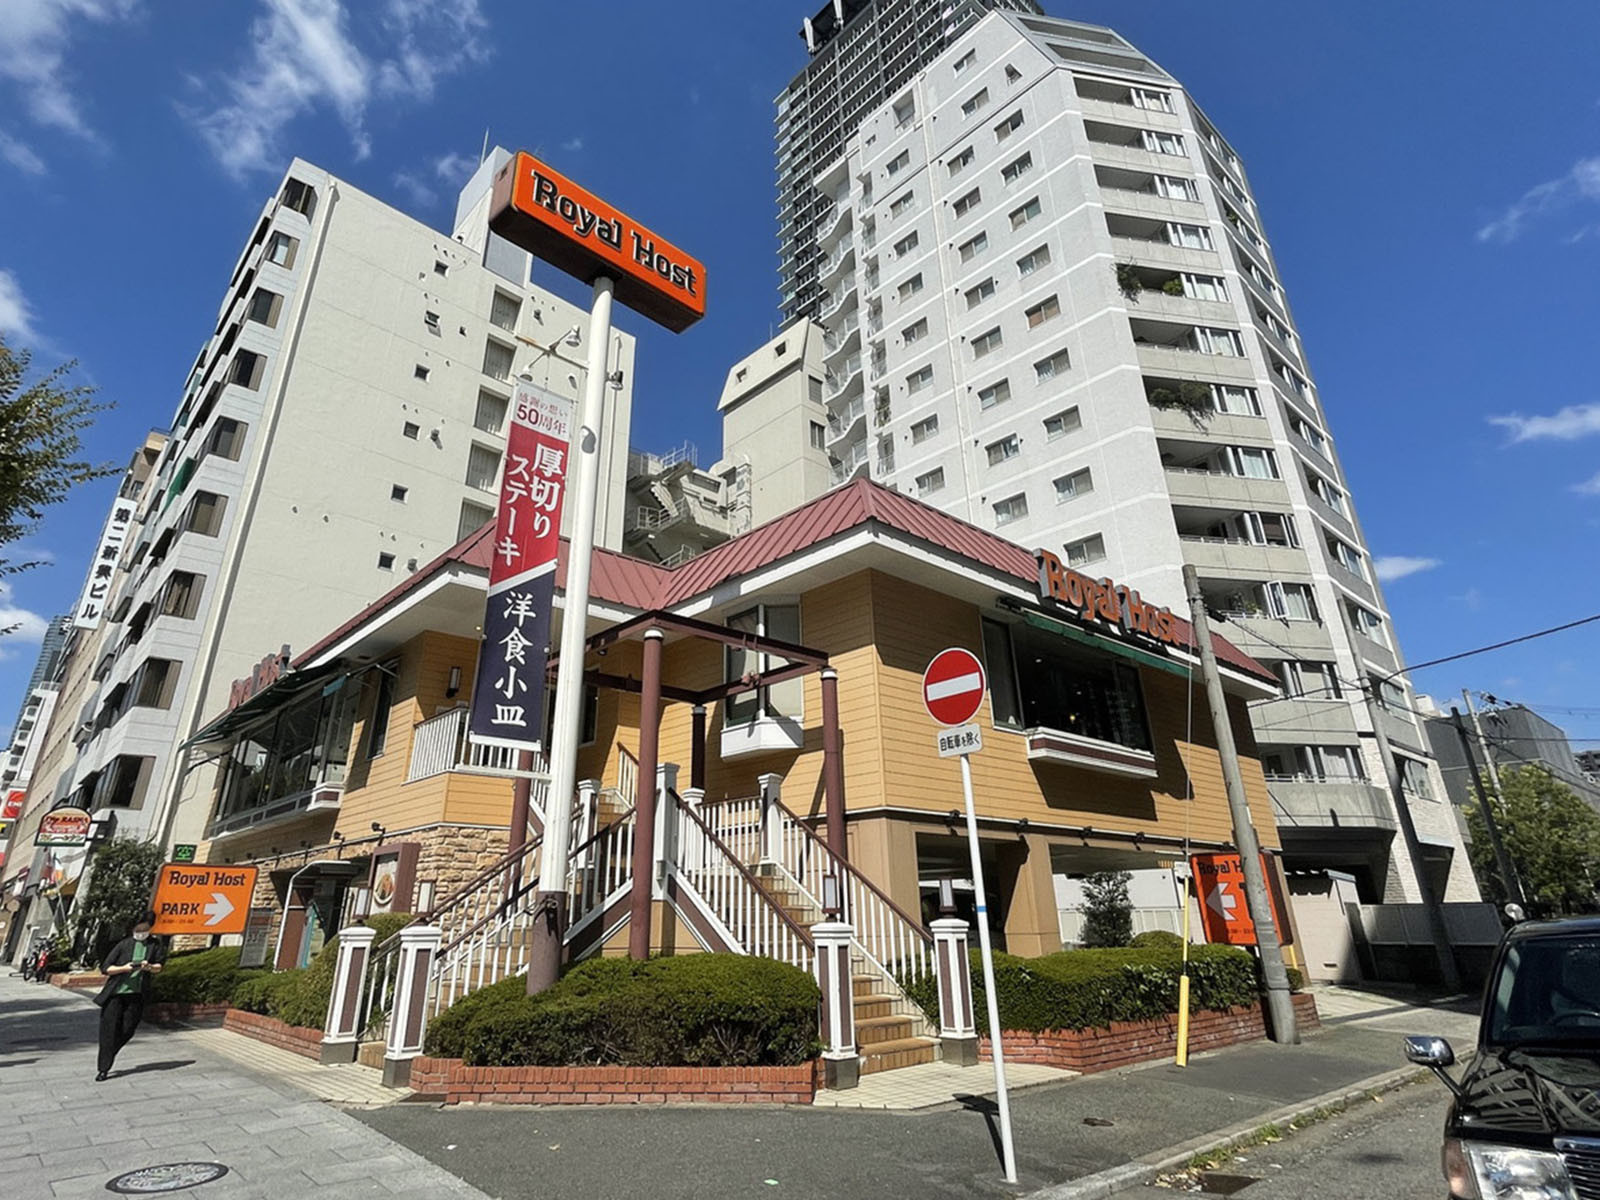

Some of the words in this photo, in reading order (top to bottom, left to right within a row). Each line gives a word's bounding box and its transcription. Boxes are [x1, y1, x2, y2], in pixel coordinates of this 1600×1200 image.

[531, 168, 624, 253] Royal
[630, 228, 697, 297] Host
[517, 403, 567, 435] 50周年
[497, 454, 530, 567] ステーキ
[529, 443, 564, 539] 厚切り
[1033, 548, 1120, 622] Royal
[1115, 584, 1181, 646] Host
[491, 590, 537, 727] 洋食小皿
[940, 731, 980, 752] 自転車を除く
[169, 871, 210, 888] Royal
[213, 872, 247, 886] Host
[1199, 860, 1231, 875] Royal
[161, 903, 200, 915] PARK
